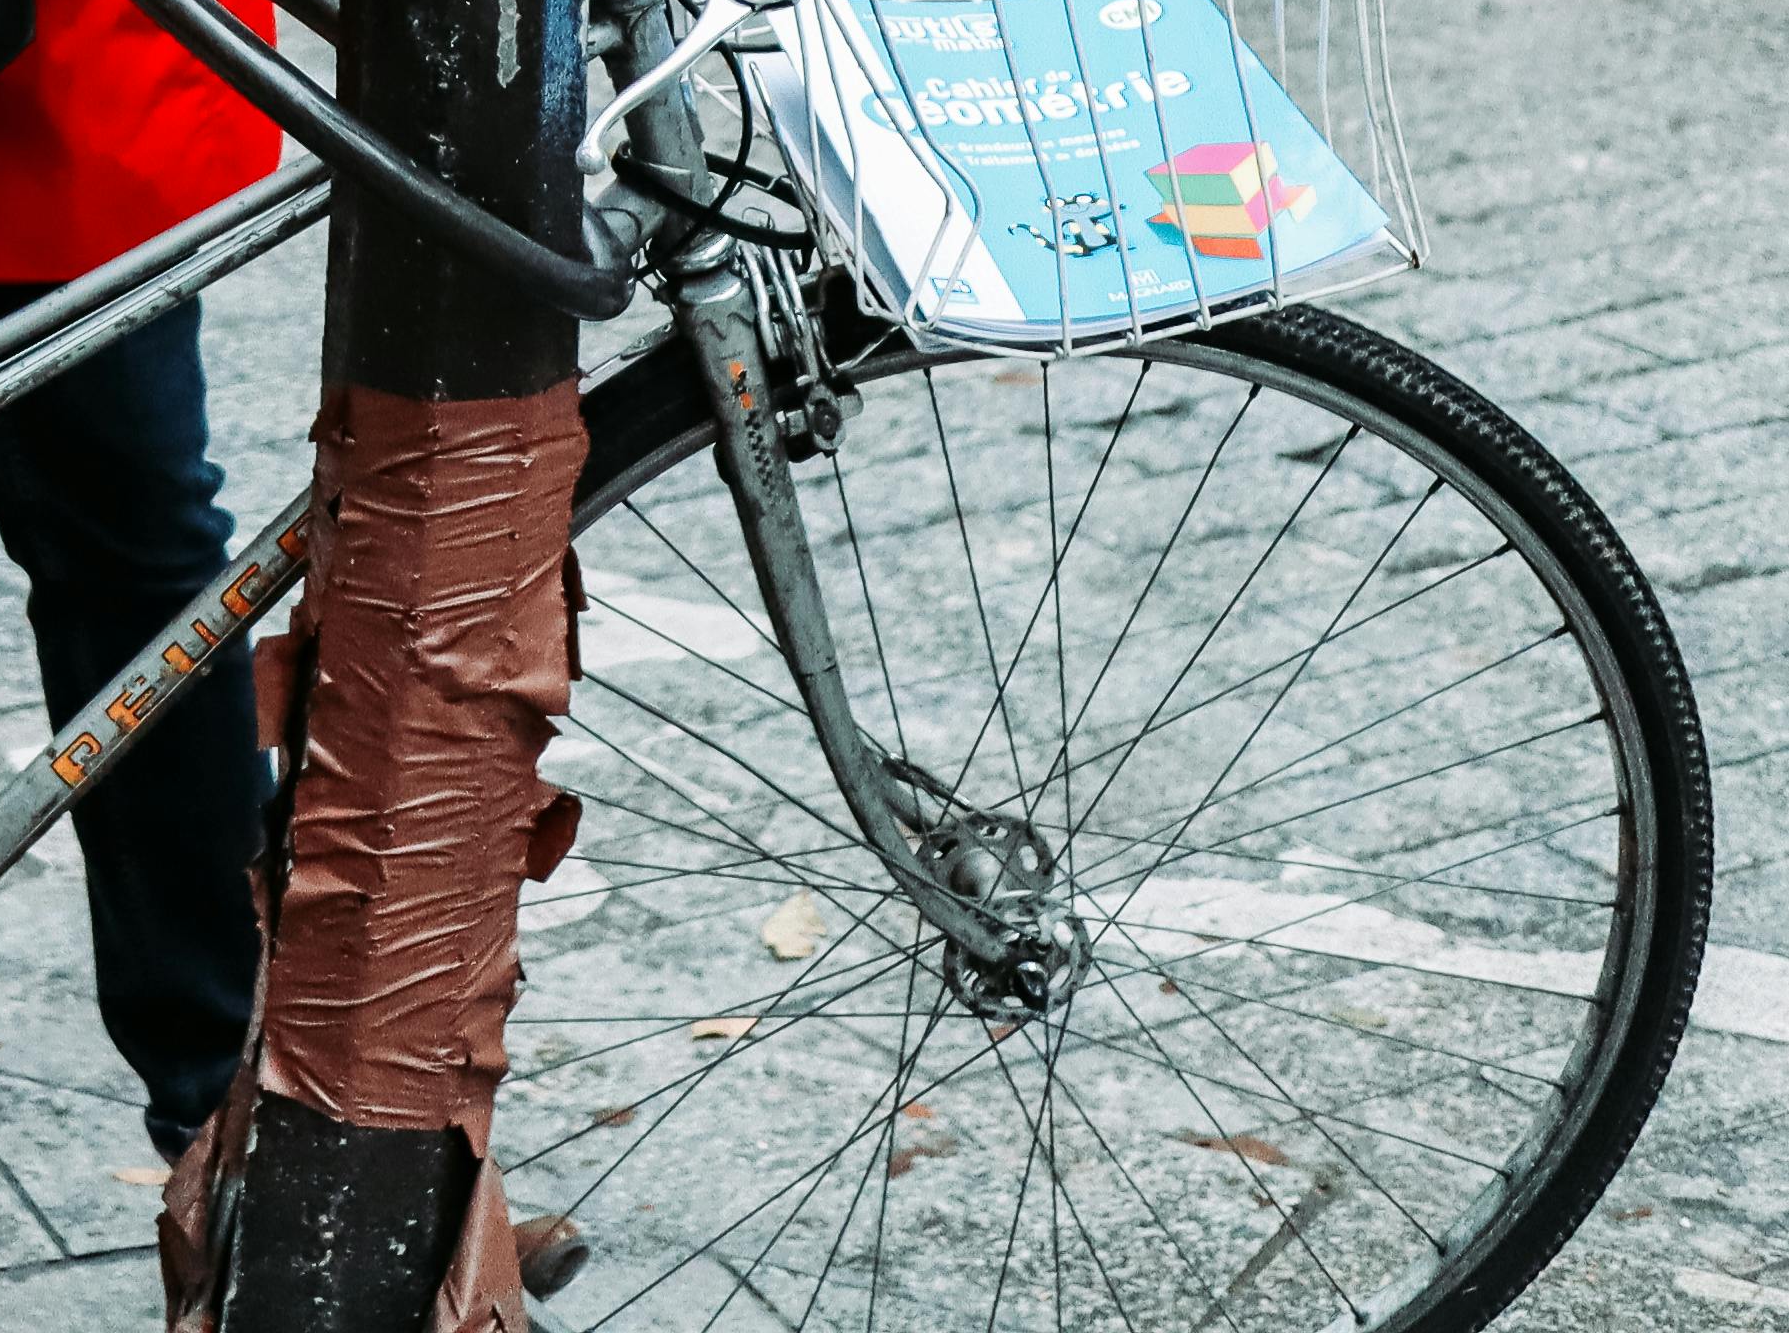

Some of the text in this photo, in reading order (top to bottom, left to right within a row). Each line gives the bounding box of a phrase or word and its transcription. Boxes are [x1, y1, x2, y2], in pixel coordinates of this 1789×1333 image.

[925, 76, 1038, 99] Cahier
[872, 69, 1193, 133] géométrie
[1107, 279, 1192, 303] MGNARD
